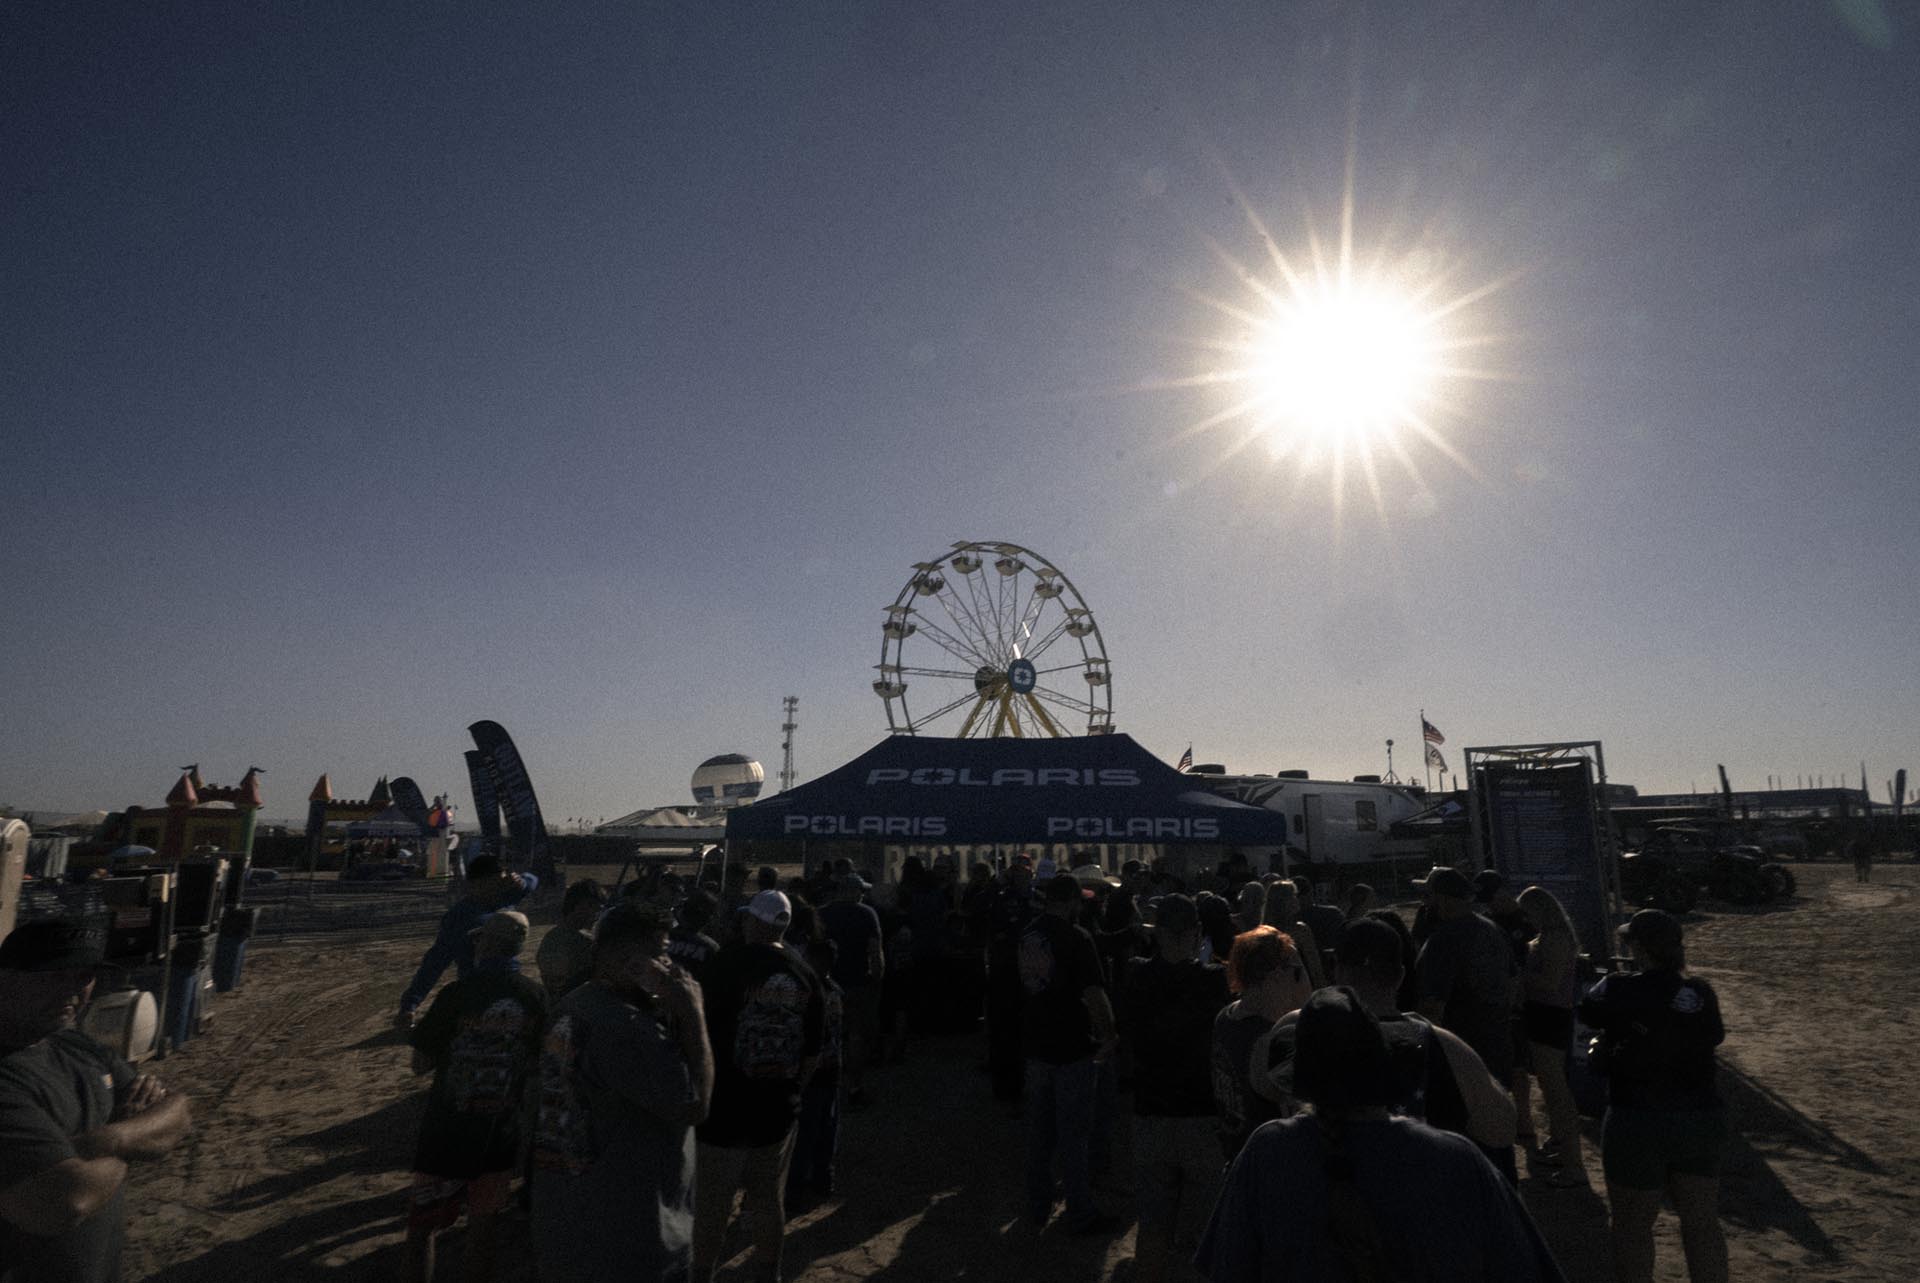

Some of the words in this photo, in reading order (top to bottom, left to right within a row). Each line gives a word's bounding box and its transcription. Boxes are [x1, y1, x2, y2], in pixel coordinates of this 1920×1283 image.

[865, 768, 1141, 786] POLARIS
[783, 815, 947, 836] POLARIS
[1047, 816, 1220, 838] POLARIS
